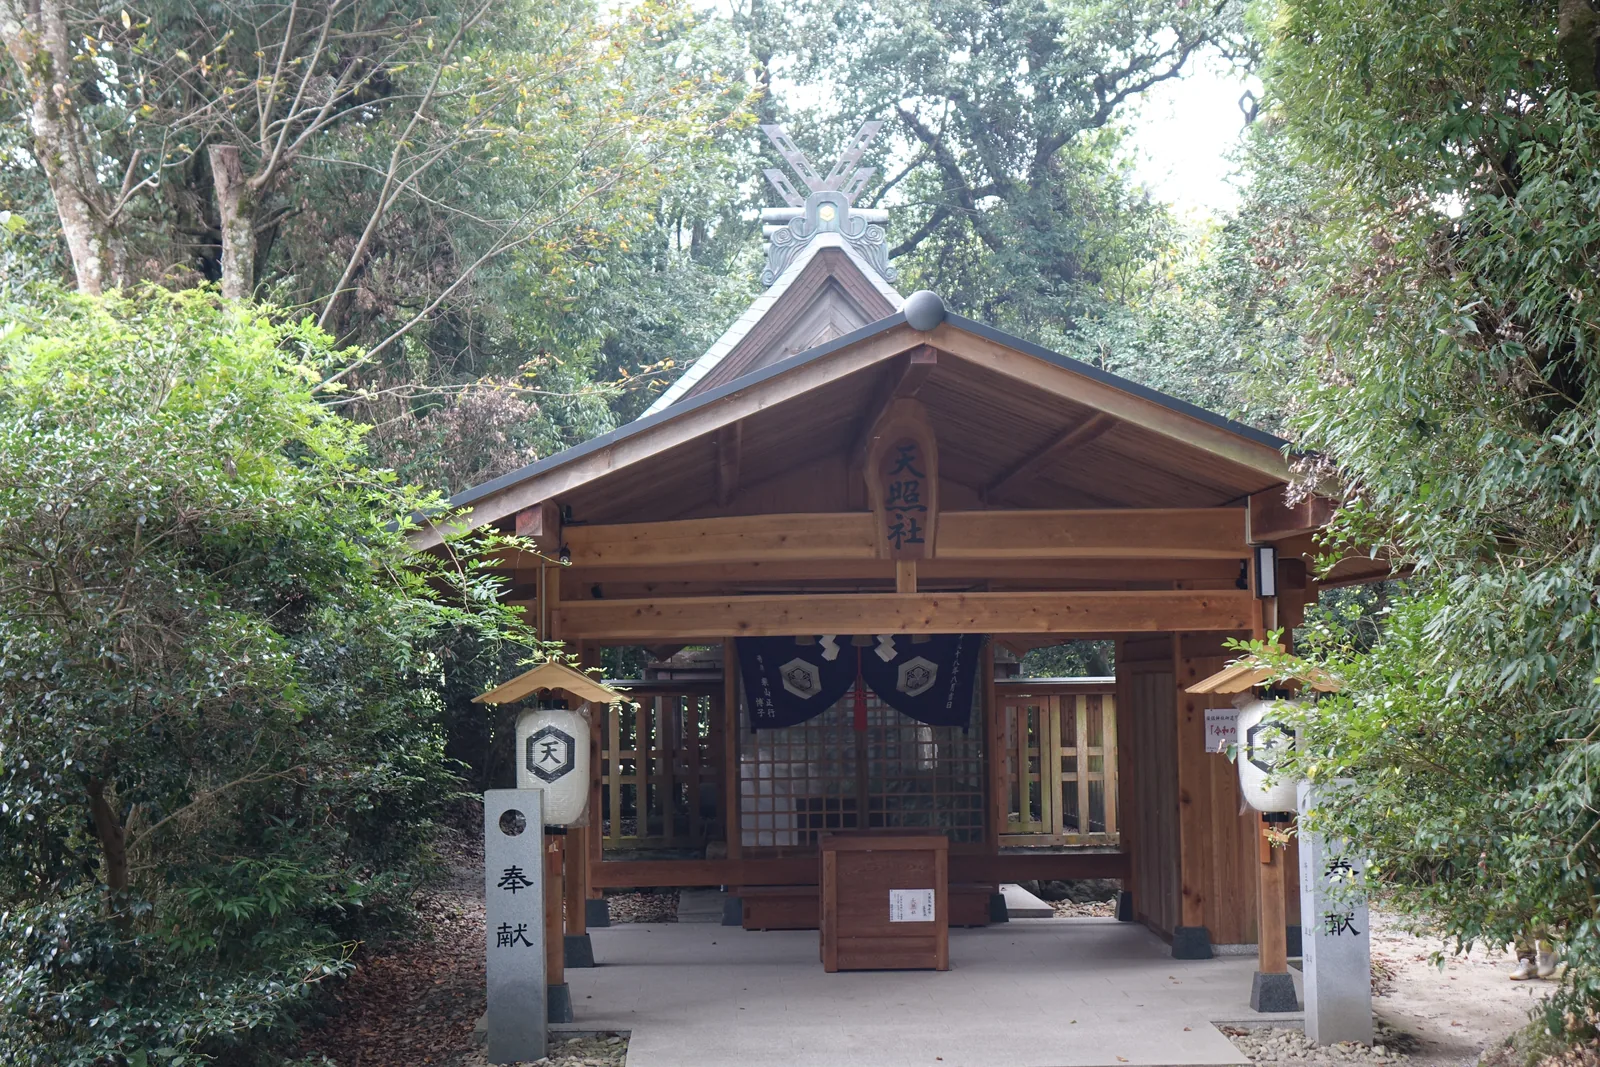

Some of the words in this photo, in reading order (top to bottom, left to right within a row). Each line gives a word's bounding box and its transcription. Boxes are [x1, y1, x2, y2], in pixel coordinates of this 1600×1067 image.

[885, 444, 928, 550] 天照社
[540, 741, 561, 764] 天
[497, 865, 534, 948] 奉献
